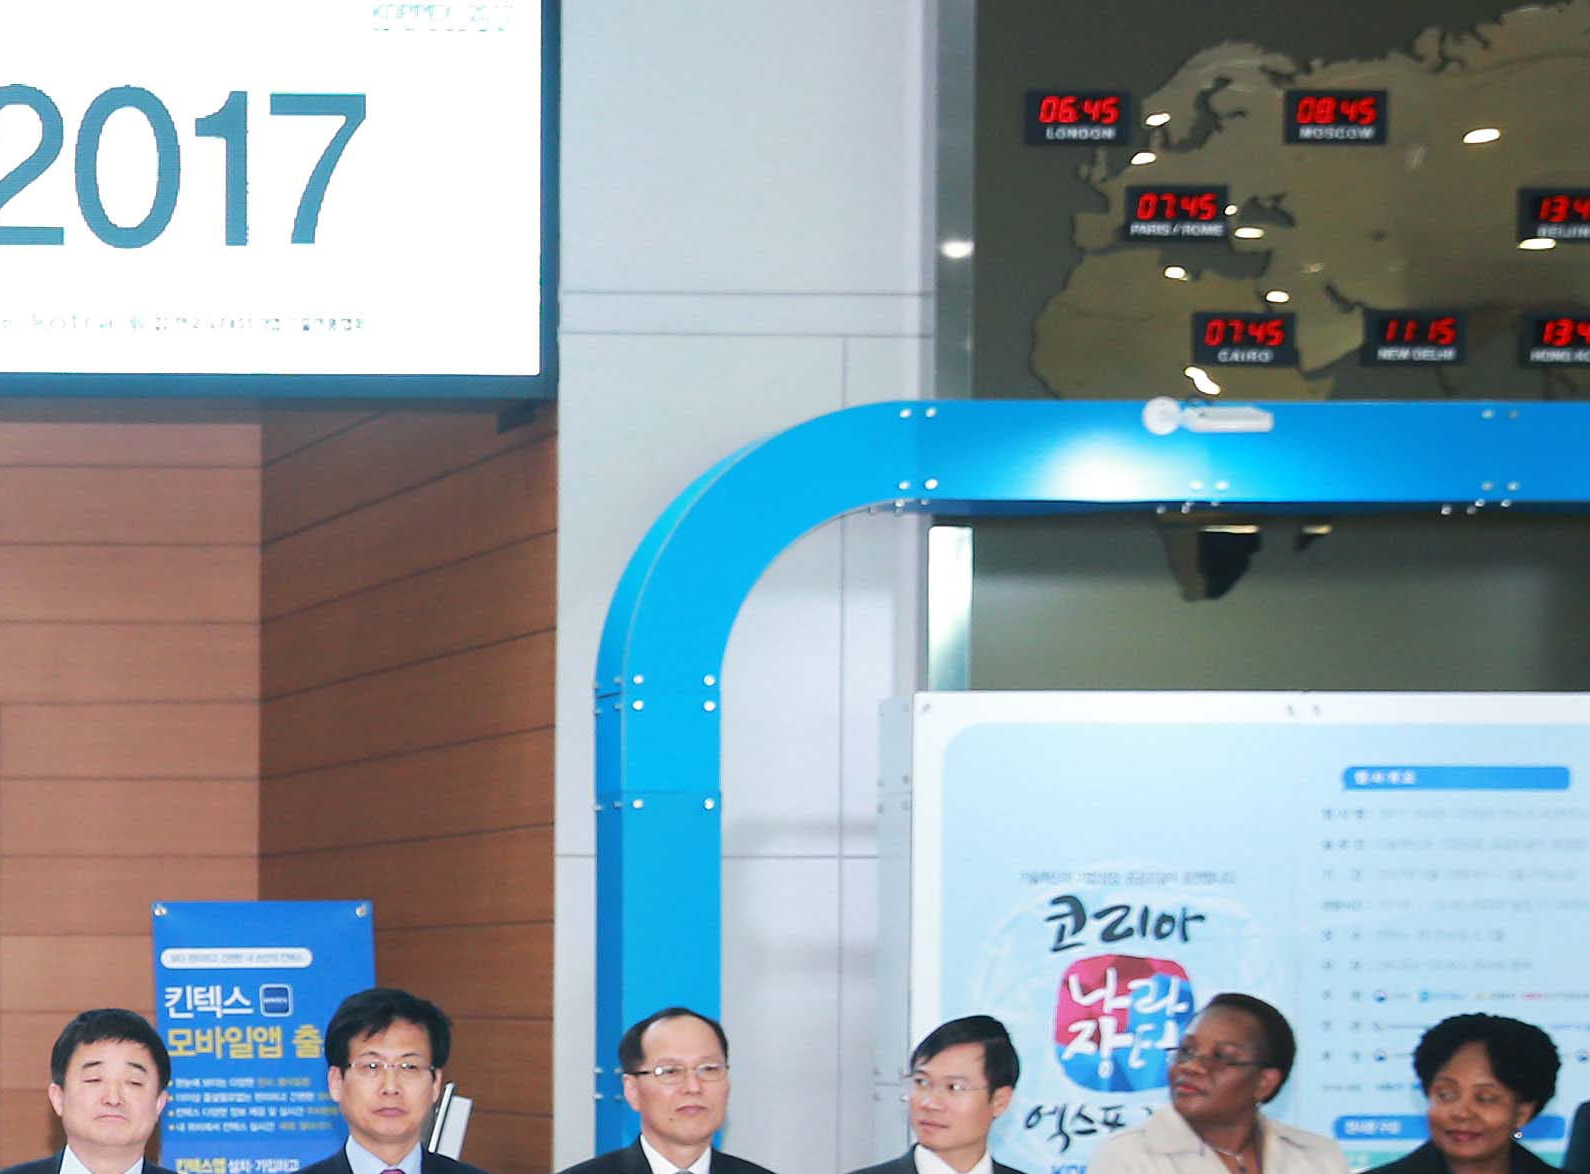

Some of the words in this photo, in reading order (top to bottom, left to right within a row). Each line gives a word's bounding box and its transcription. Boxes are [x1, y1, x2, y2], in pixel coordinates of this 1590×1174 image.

[1045, 126, 1117, 140] LONDON
[1299, 126, 1375, 140] MOSCOW
[1218, 349, 1272, 363] CAIRO
[1045, 894, 1206, 952] 코리아
[164, 984, 254, 1019] 킨텍스
[1067, 966, 1190, 1014] 나라
[167, 1026, 283, 1060] 모바일앱
[1061, 1016, 1181, 1078] 장터
[1025, 1104, 1126, 1152] 엑스포
